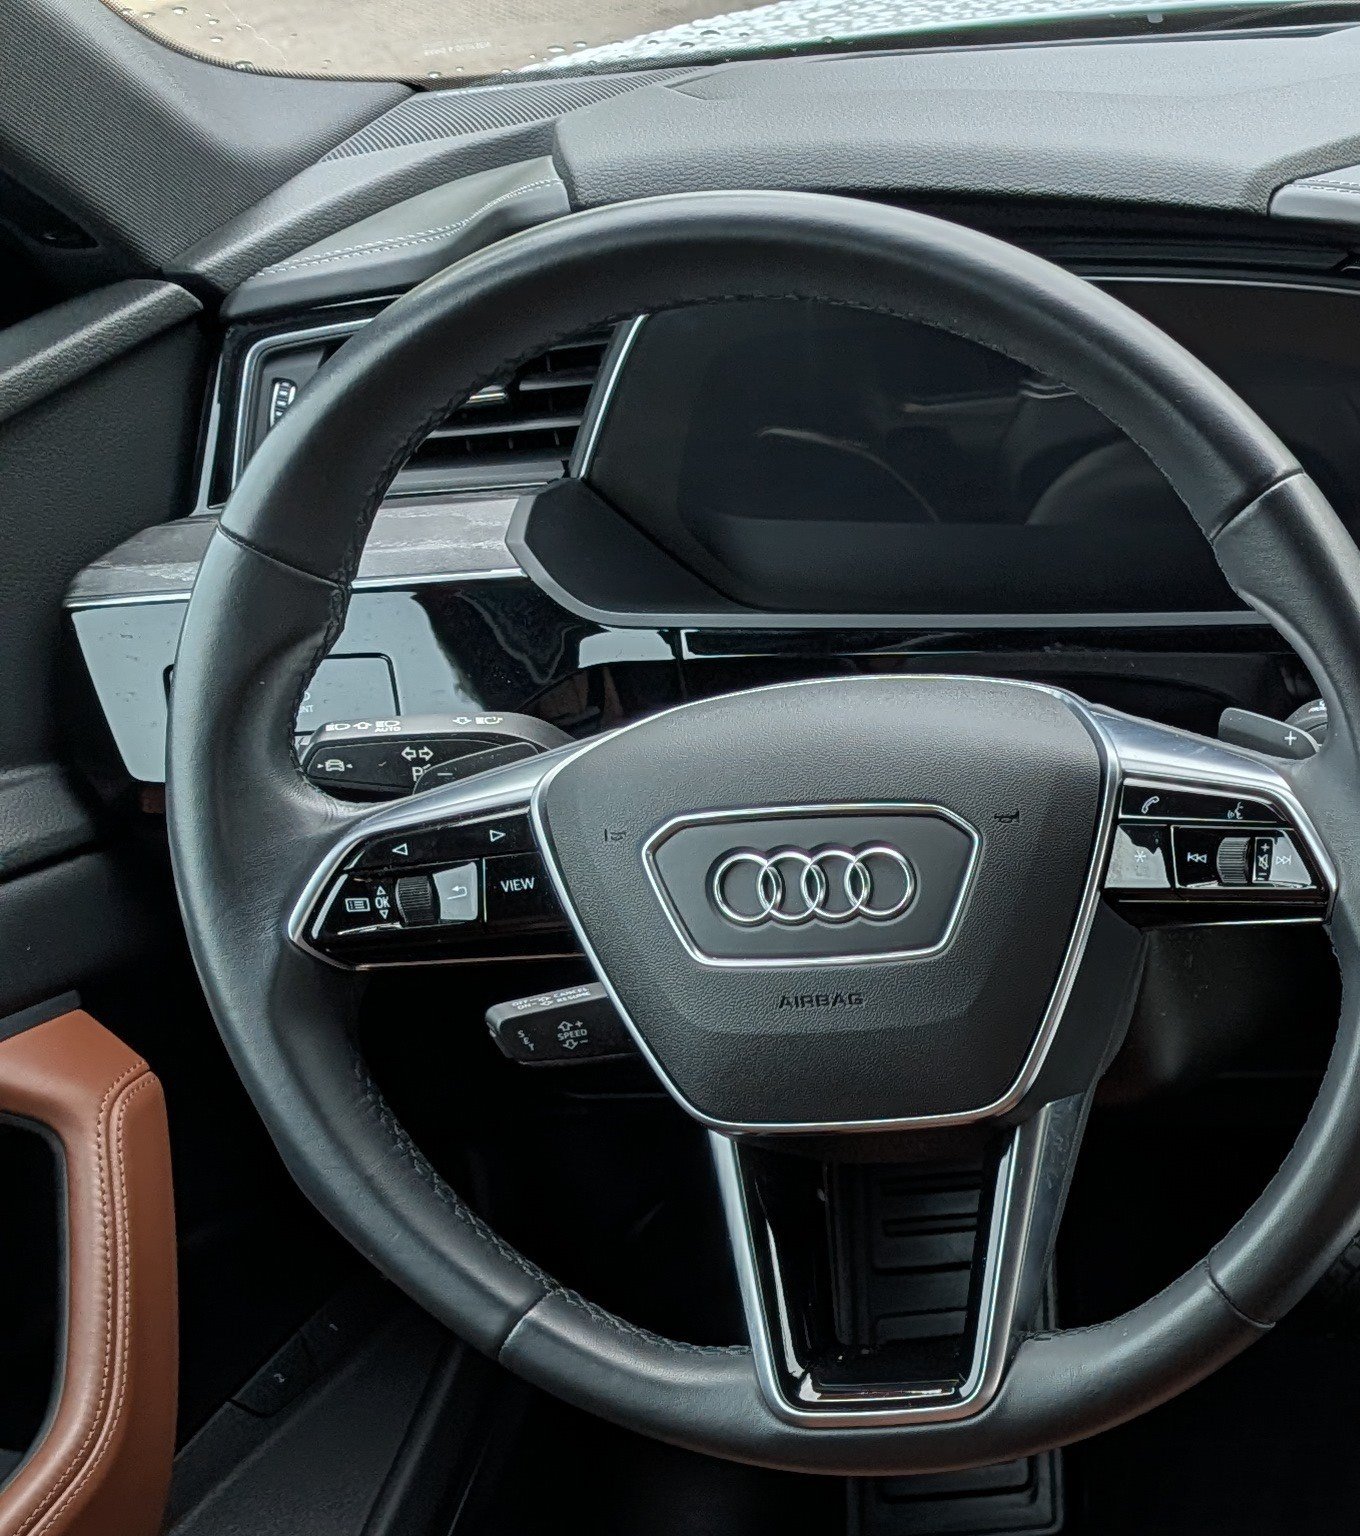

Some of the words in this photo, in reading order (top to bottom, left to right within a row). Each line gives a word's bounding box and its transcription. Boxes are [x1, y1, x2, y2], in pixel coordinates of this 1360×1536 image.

[500, 877, 535, 893] VIEW
[375, 896, 390, 909] OK
[779, 991, 864, 1009] AIRBAG
[557, 1028, 588, 1041] SPEED
